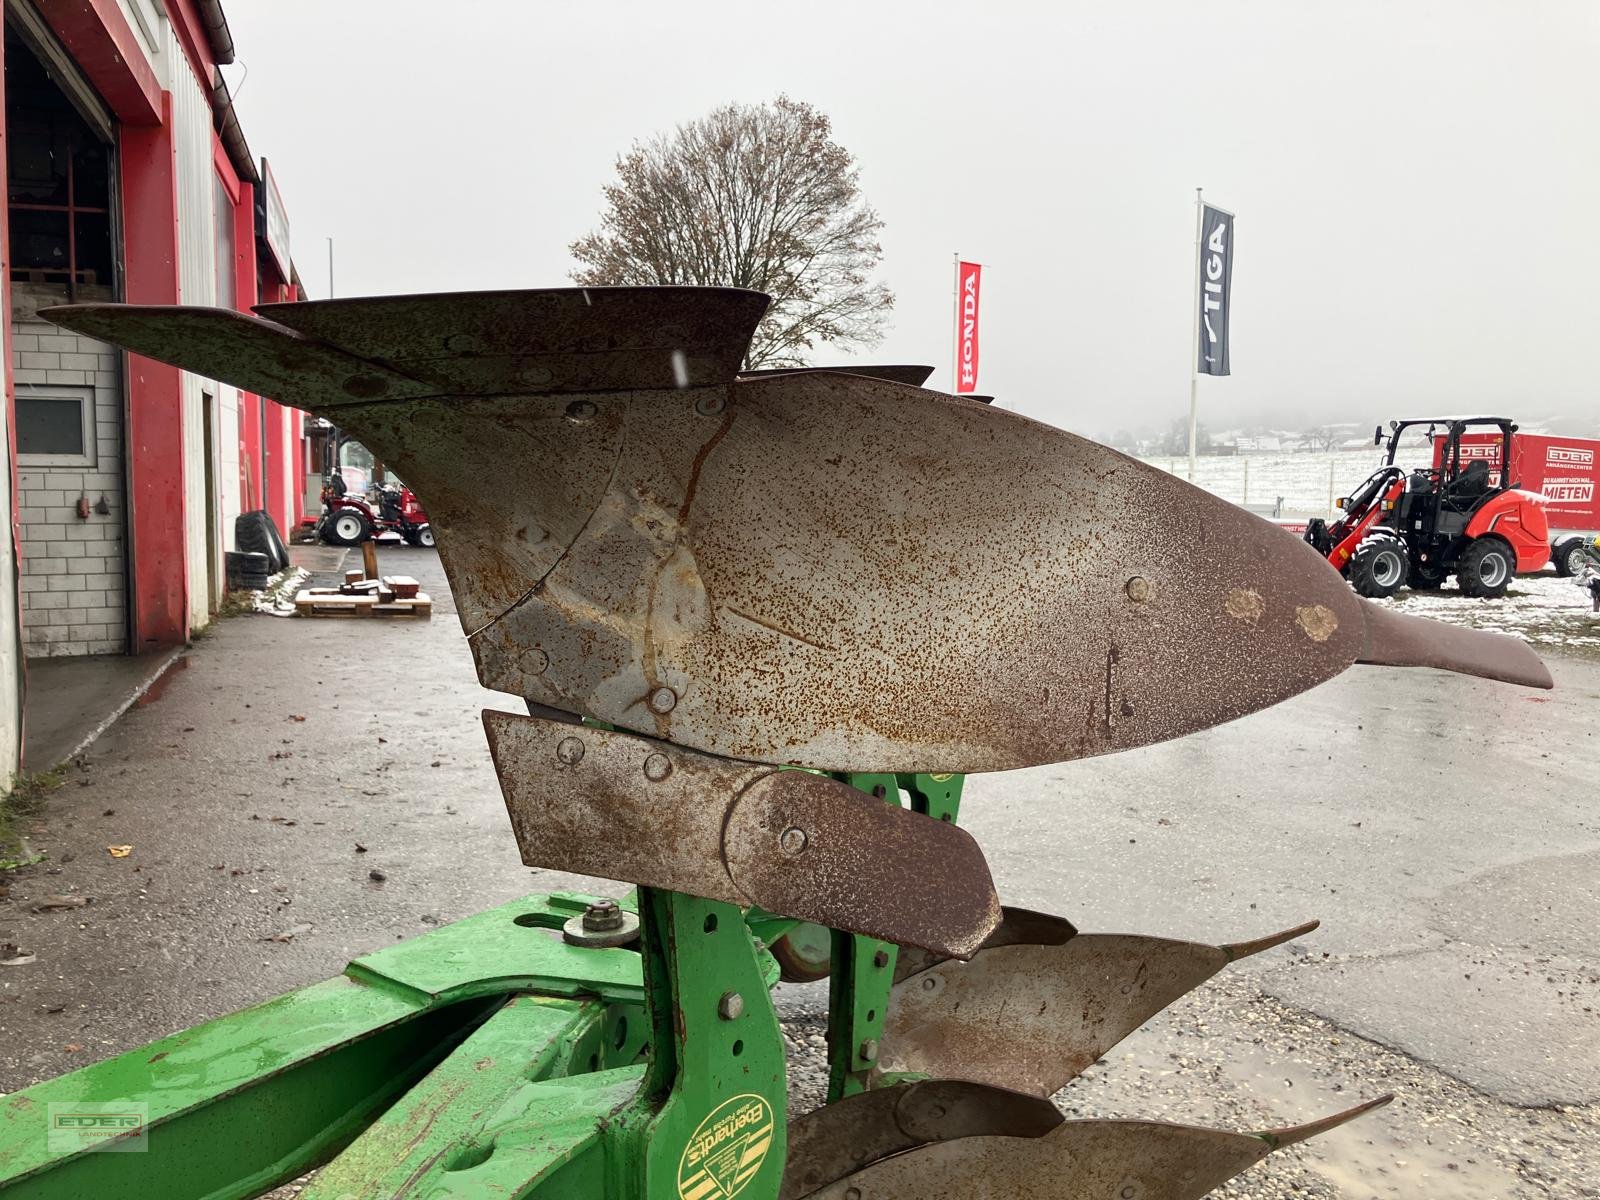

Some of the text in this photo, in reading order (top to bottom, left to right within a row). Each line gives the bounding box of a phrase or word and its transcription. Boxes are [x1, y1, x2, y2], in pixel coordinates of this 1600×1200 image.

[962, 271, 976, 386] HONDA
[1548, 449, 1592, 462] EDER
[1543, 486, 1592, 500] MIETEN
[697, 1102, 763, 1158] Eberhardt
